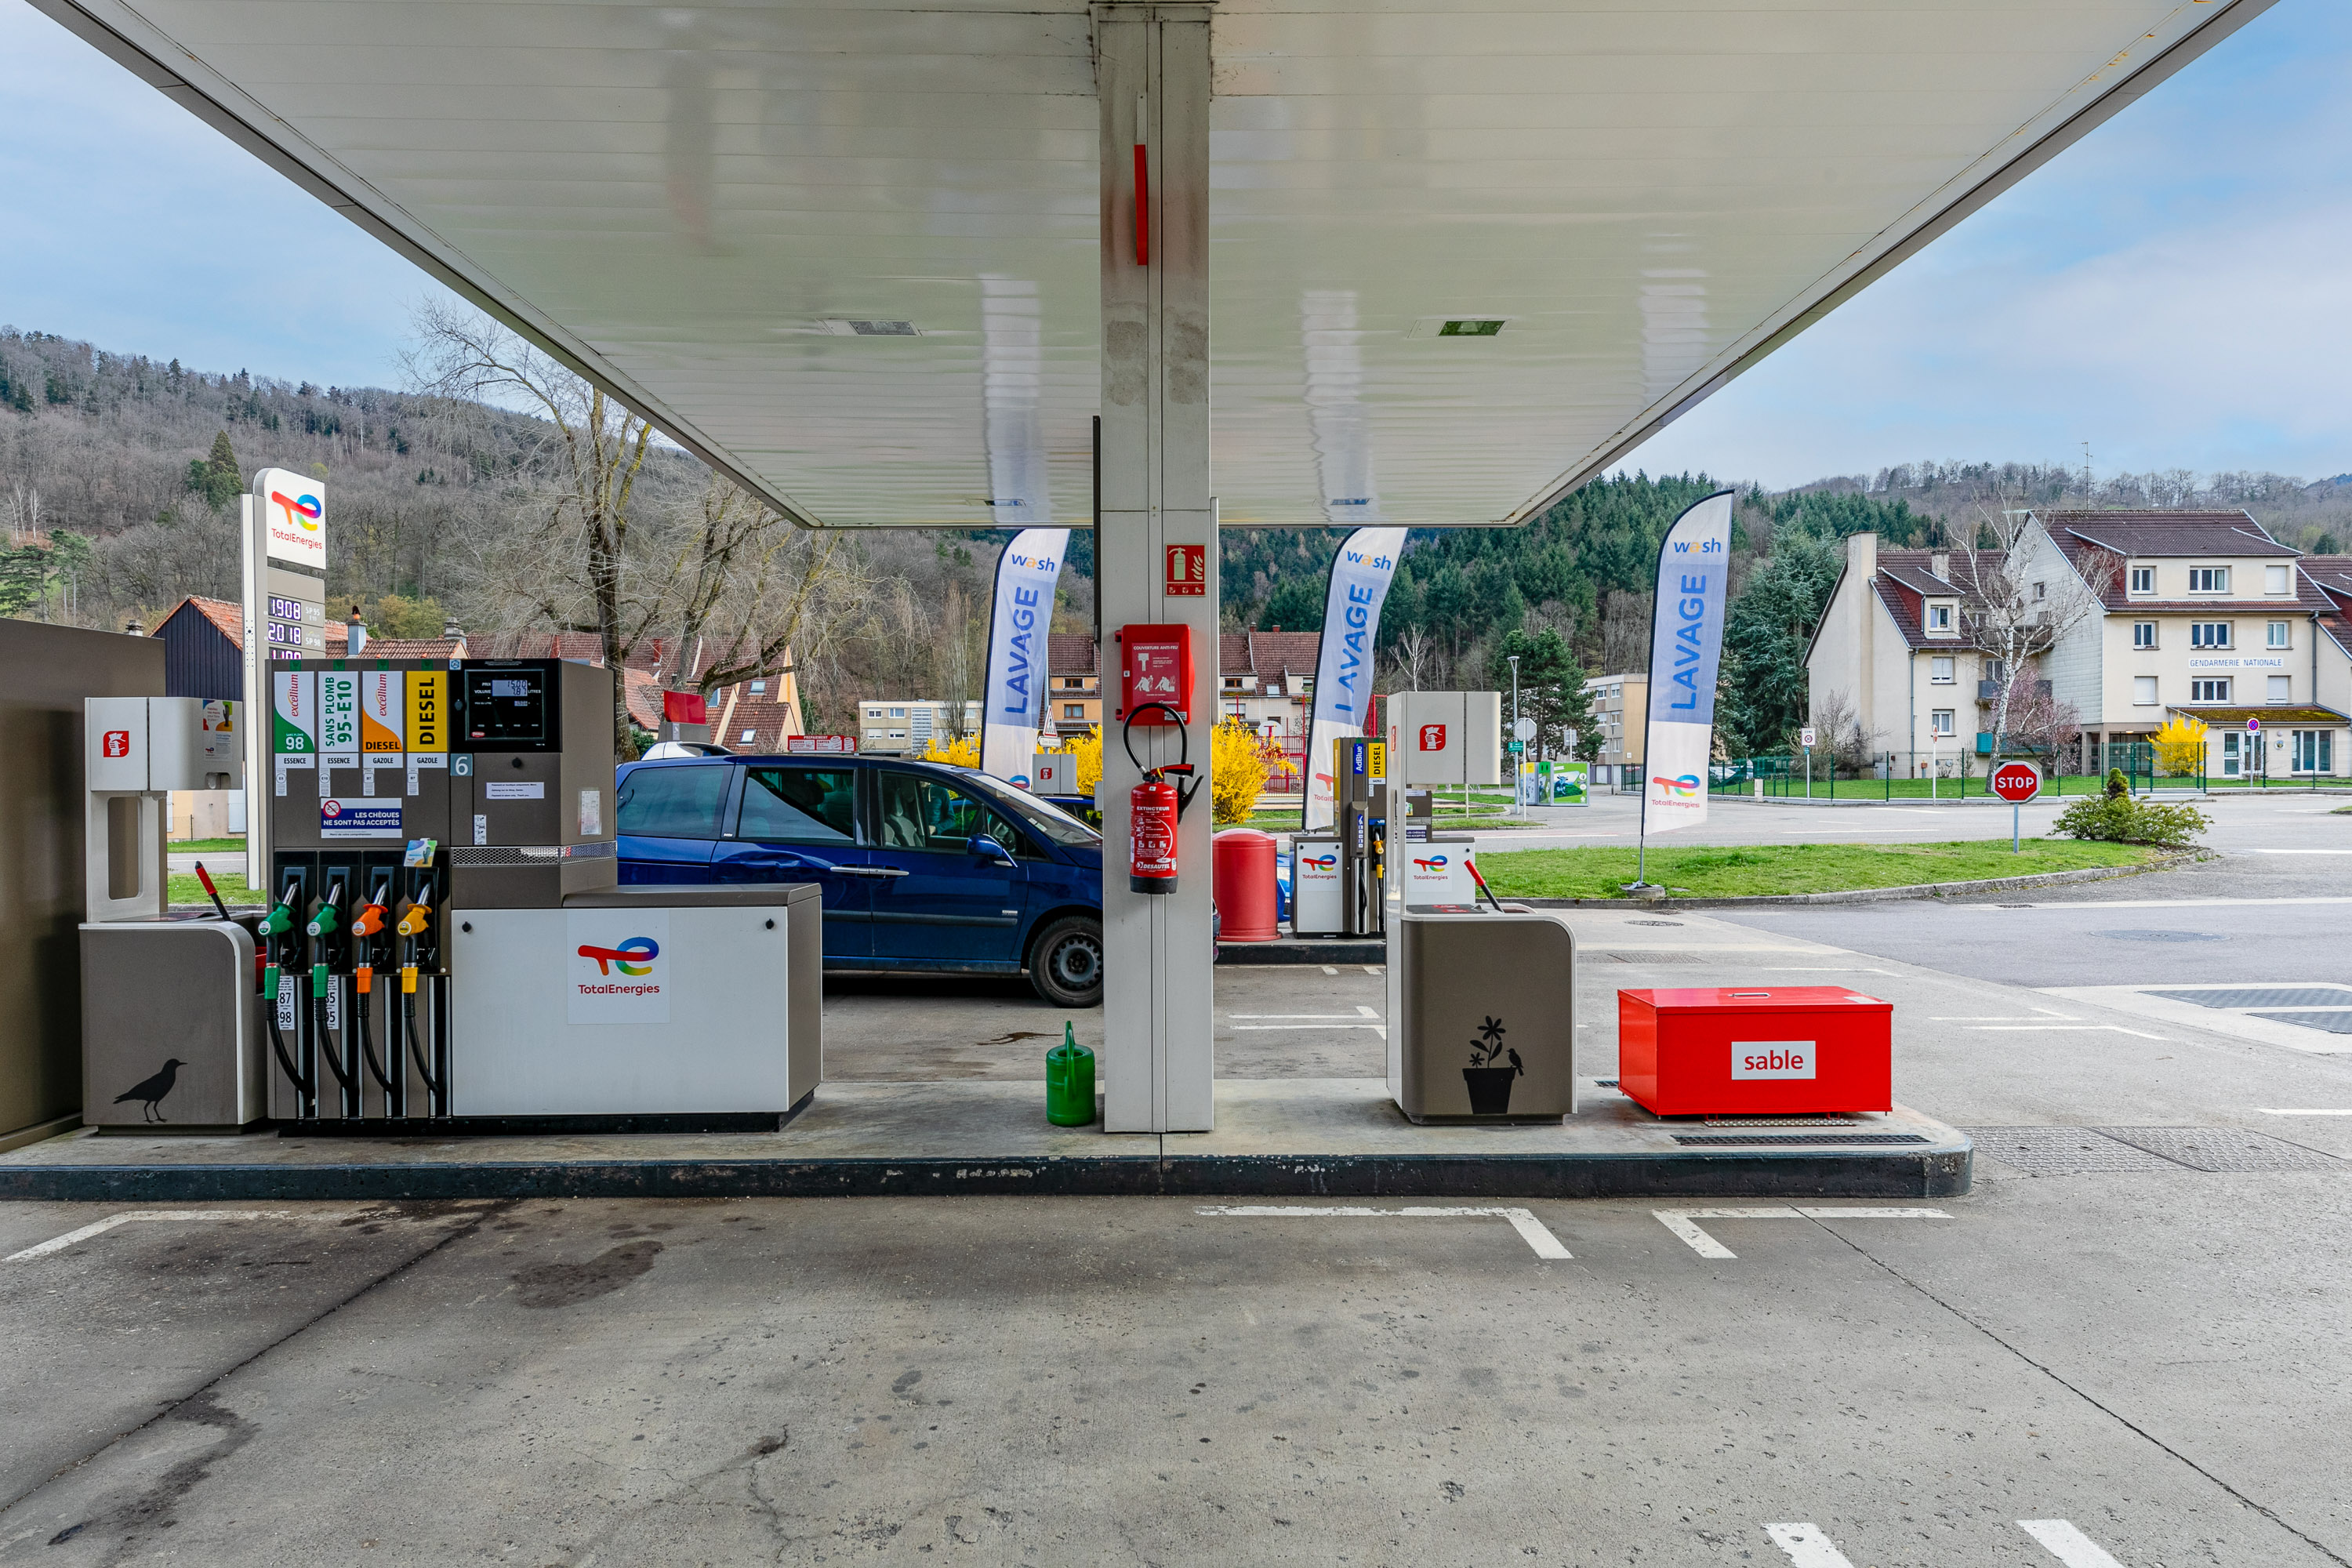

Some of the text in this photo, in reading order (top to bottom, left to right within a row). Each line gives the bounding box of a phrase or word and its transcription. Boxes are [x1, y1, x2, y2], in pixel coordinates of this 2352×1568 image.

[271, 528, 322, 550] TotalEnergies
[1674, 538, 1721, 554] wash
[1011, 554, 1054, 572] wash
[1347, 550, 1391, 571] wash
[1004, 586, 1039, 713] LAVAGE
[1335, 584, 1373, 712] LAVAGE
[1671, 575, 1707, 710] LAVAGE
[289, 674, 299, 717] excellium
[377, 674, 387, 717] excellium
[325, 677, 335, 746] SANS PLOMB
[419, 677, 435, 745] DIESEL
[285, 737, 304, 750] 98
[456, 756, 468, 775] 6
[1998, 777, 2034, 789] STOP
[1651, 799, 1700, 808] TotalEnergies
[279, 993, 291, 1004] 87
[578, 983, 660, 996] TotalEnergies
[279, 1011, 292, 1023] 98
[1744, 1050, 1804, 1070] sable
